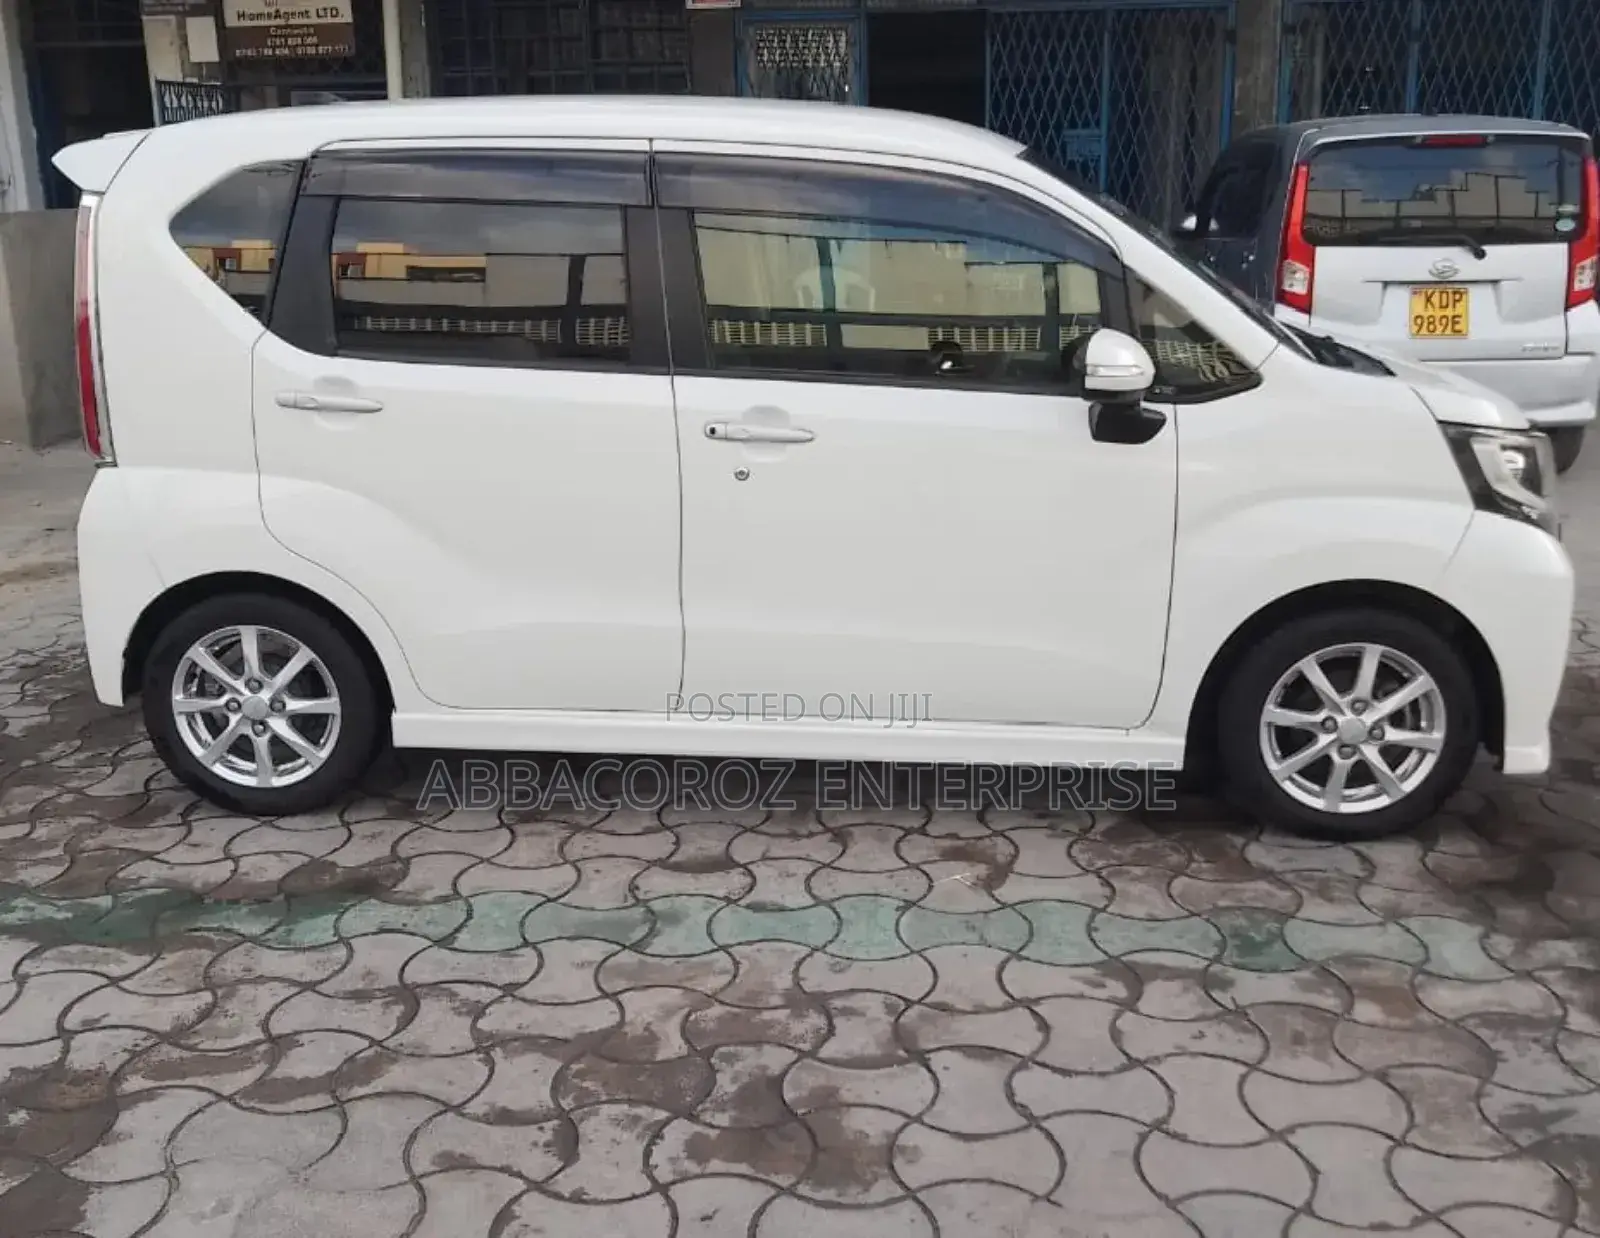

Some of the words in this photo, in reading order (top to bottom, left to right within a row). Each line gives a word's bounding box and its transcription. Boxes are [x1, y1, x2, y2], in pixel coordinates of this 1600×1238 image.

[236, 9, 312, 23] HomeAgent
[316, 7, 345, 19] LTD.
[1424, 290, 1463, 310] KDP
[1413, 314, 1463, 334] 989E
